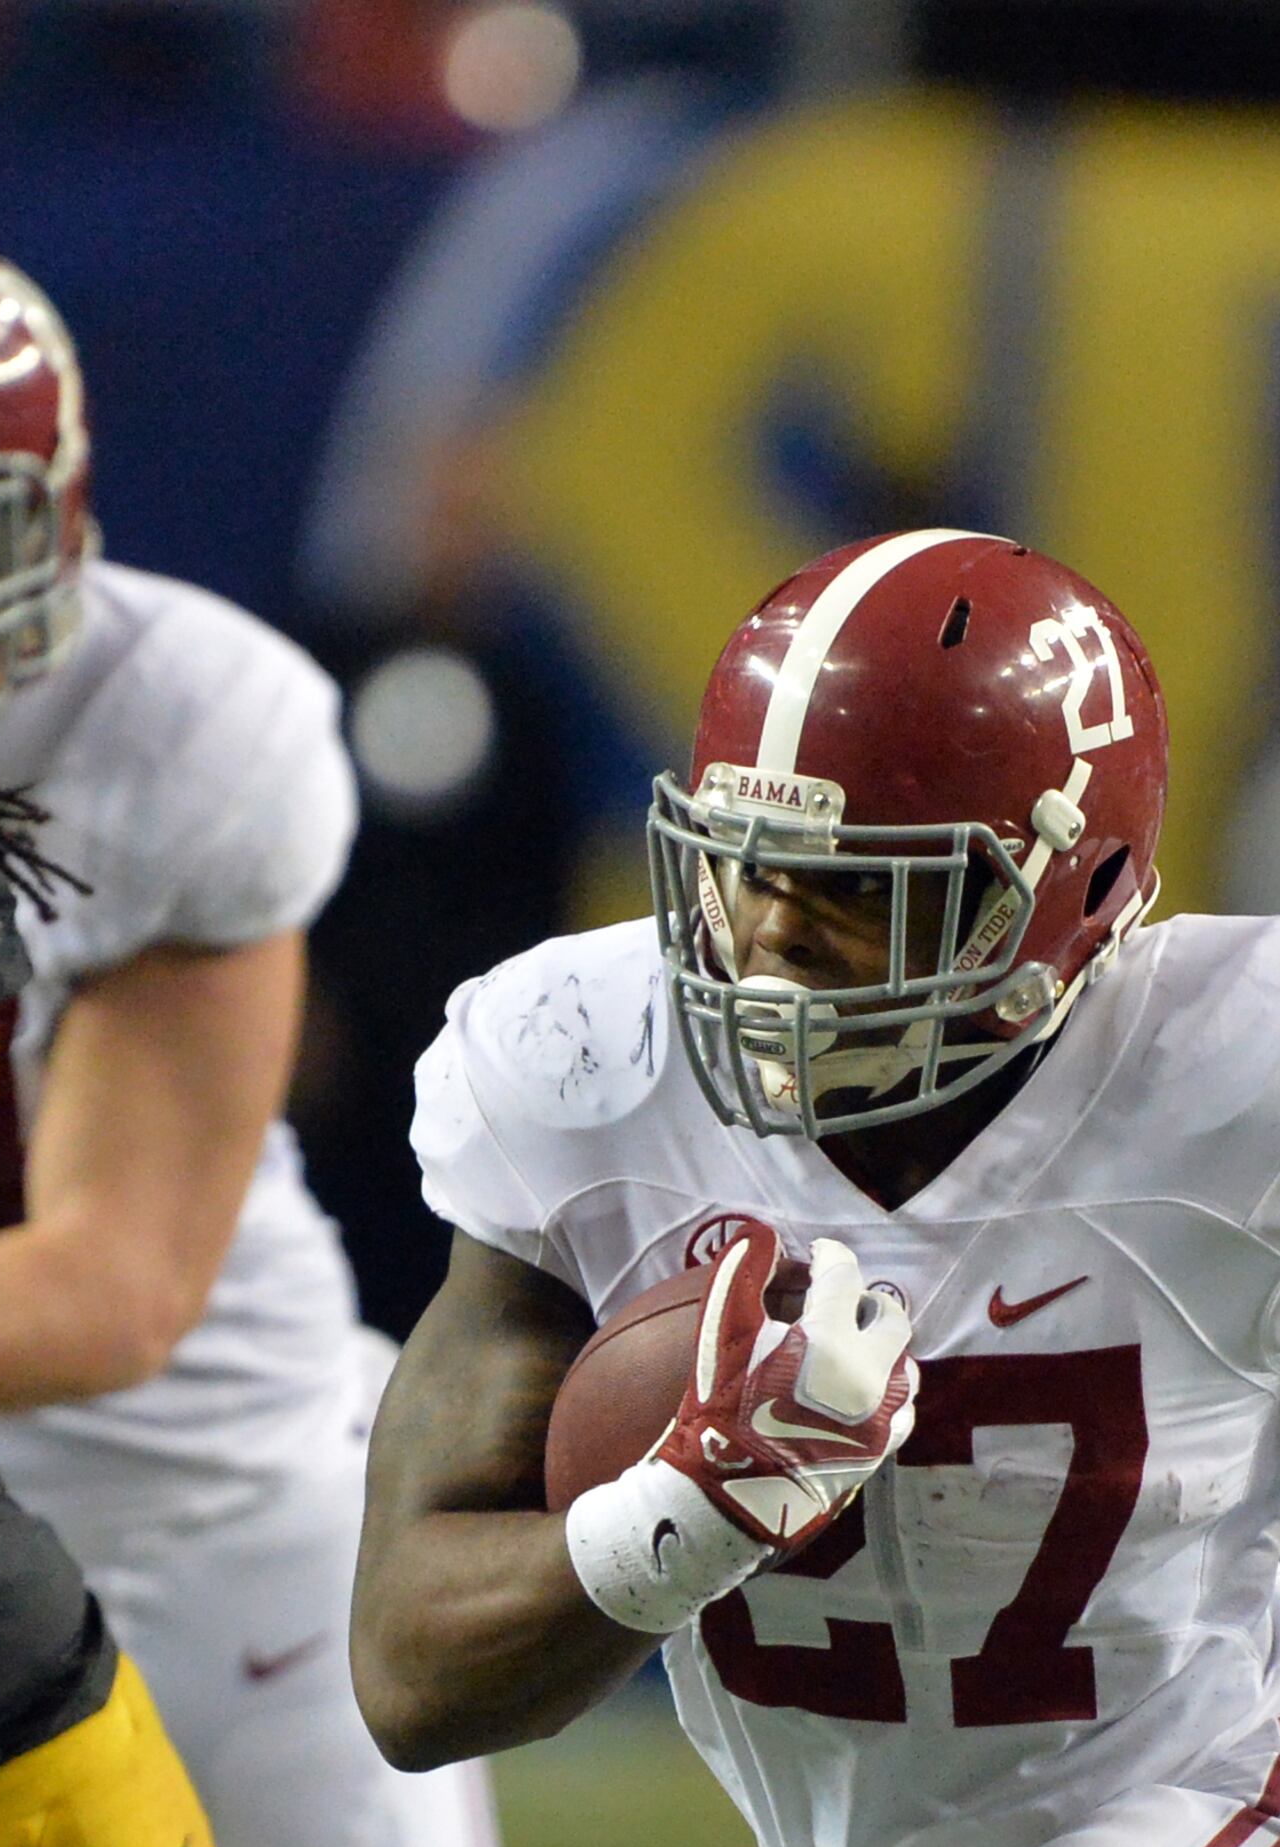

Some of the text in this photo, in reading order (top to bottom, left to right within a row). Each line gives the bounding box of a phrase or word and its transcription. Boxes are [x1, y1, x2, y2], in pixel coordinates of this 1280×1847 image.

[1029, 602, 1134, 755] 27
[738, 775, 802, 807] BAMA
[703, 886, 726, 933] TIDE
[977, 903, 1015, 943] TIDE
[699, 1343, 1149, 1728] 27
